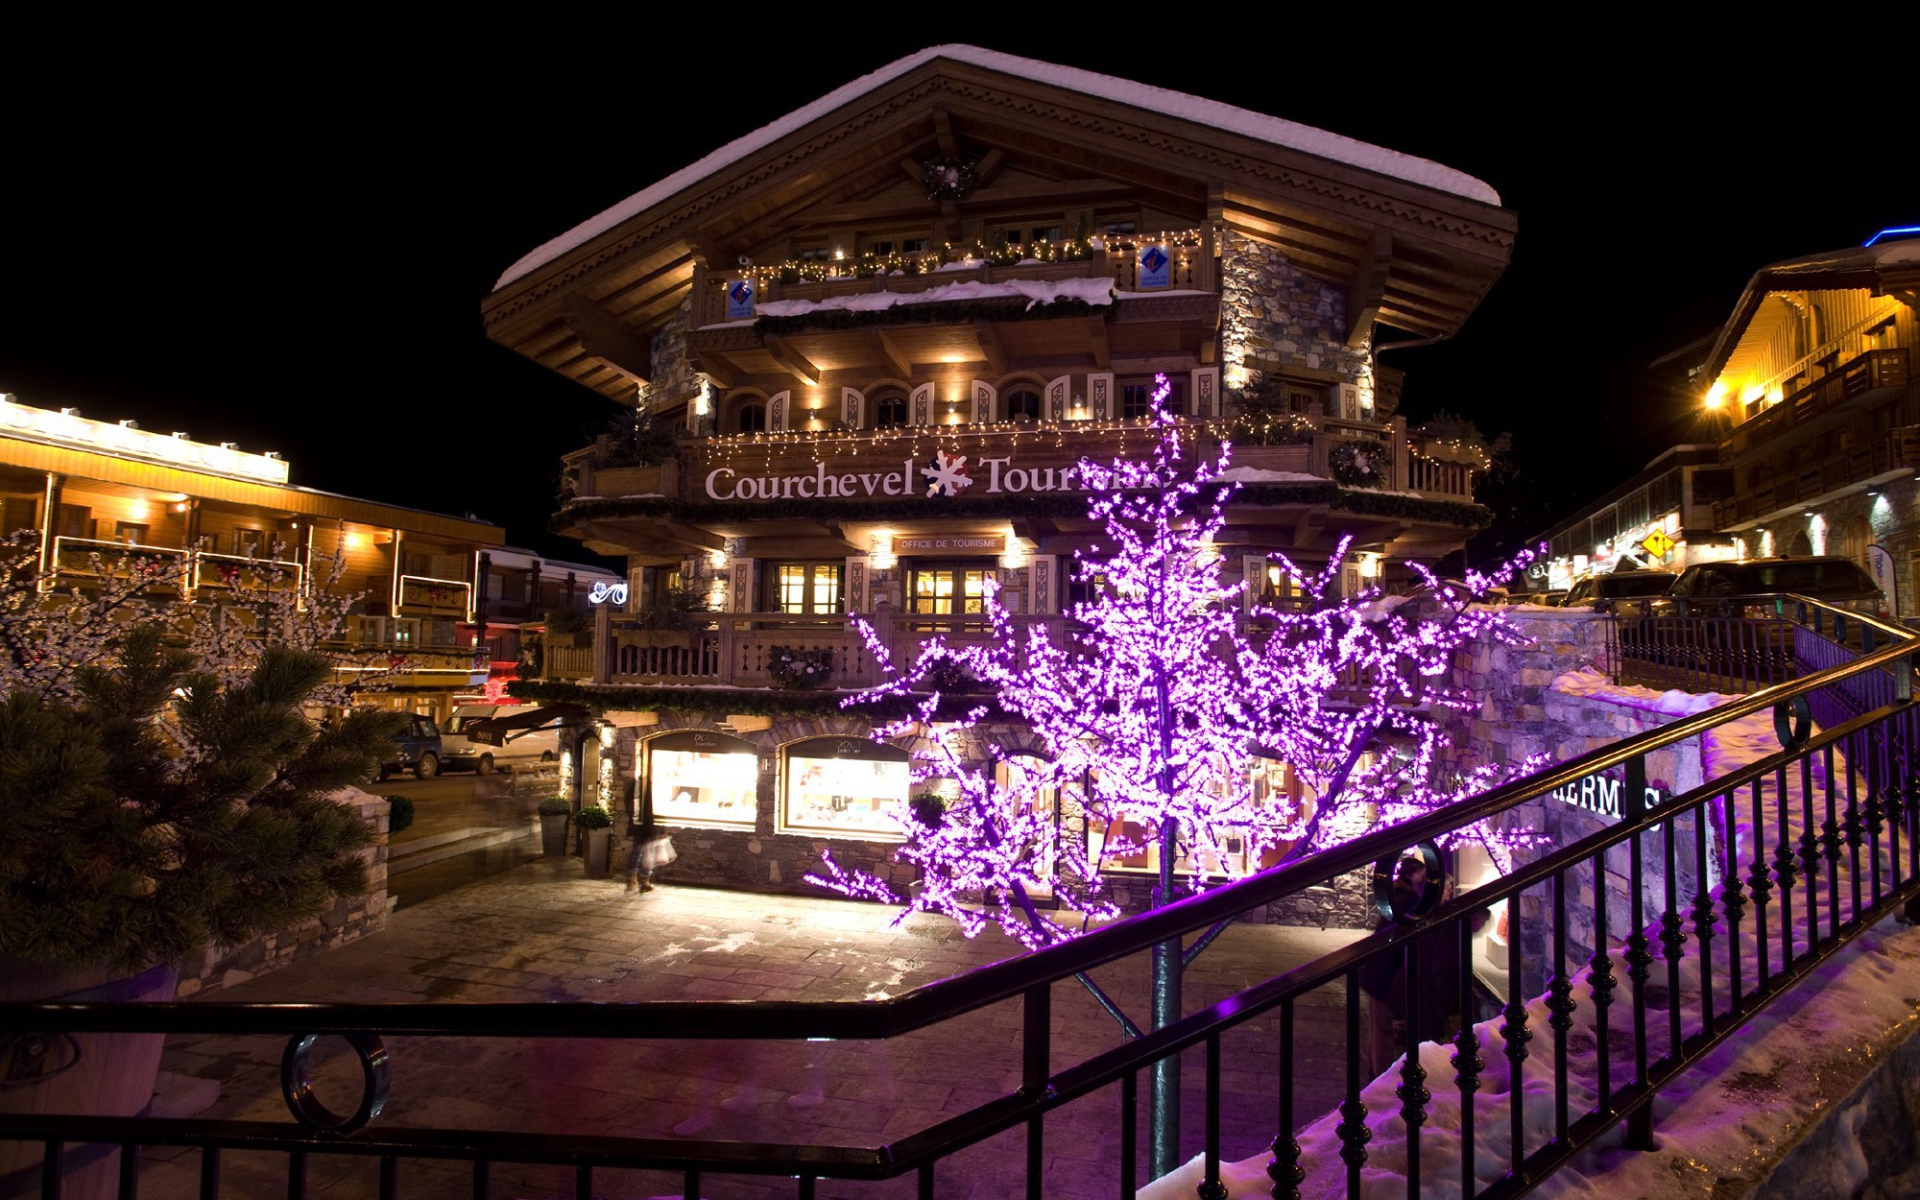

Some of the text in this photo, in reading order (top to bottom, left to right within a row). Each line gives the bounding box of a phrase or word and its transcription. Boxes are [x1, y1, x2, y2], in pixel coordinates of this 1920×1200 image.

[705, 458, 915, 500] Courchevel
[901, 539, 997, 549] OFFICE DE TOURISME
[1552, 774, 1661, 832] ERMS
